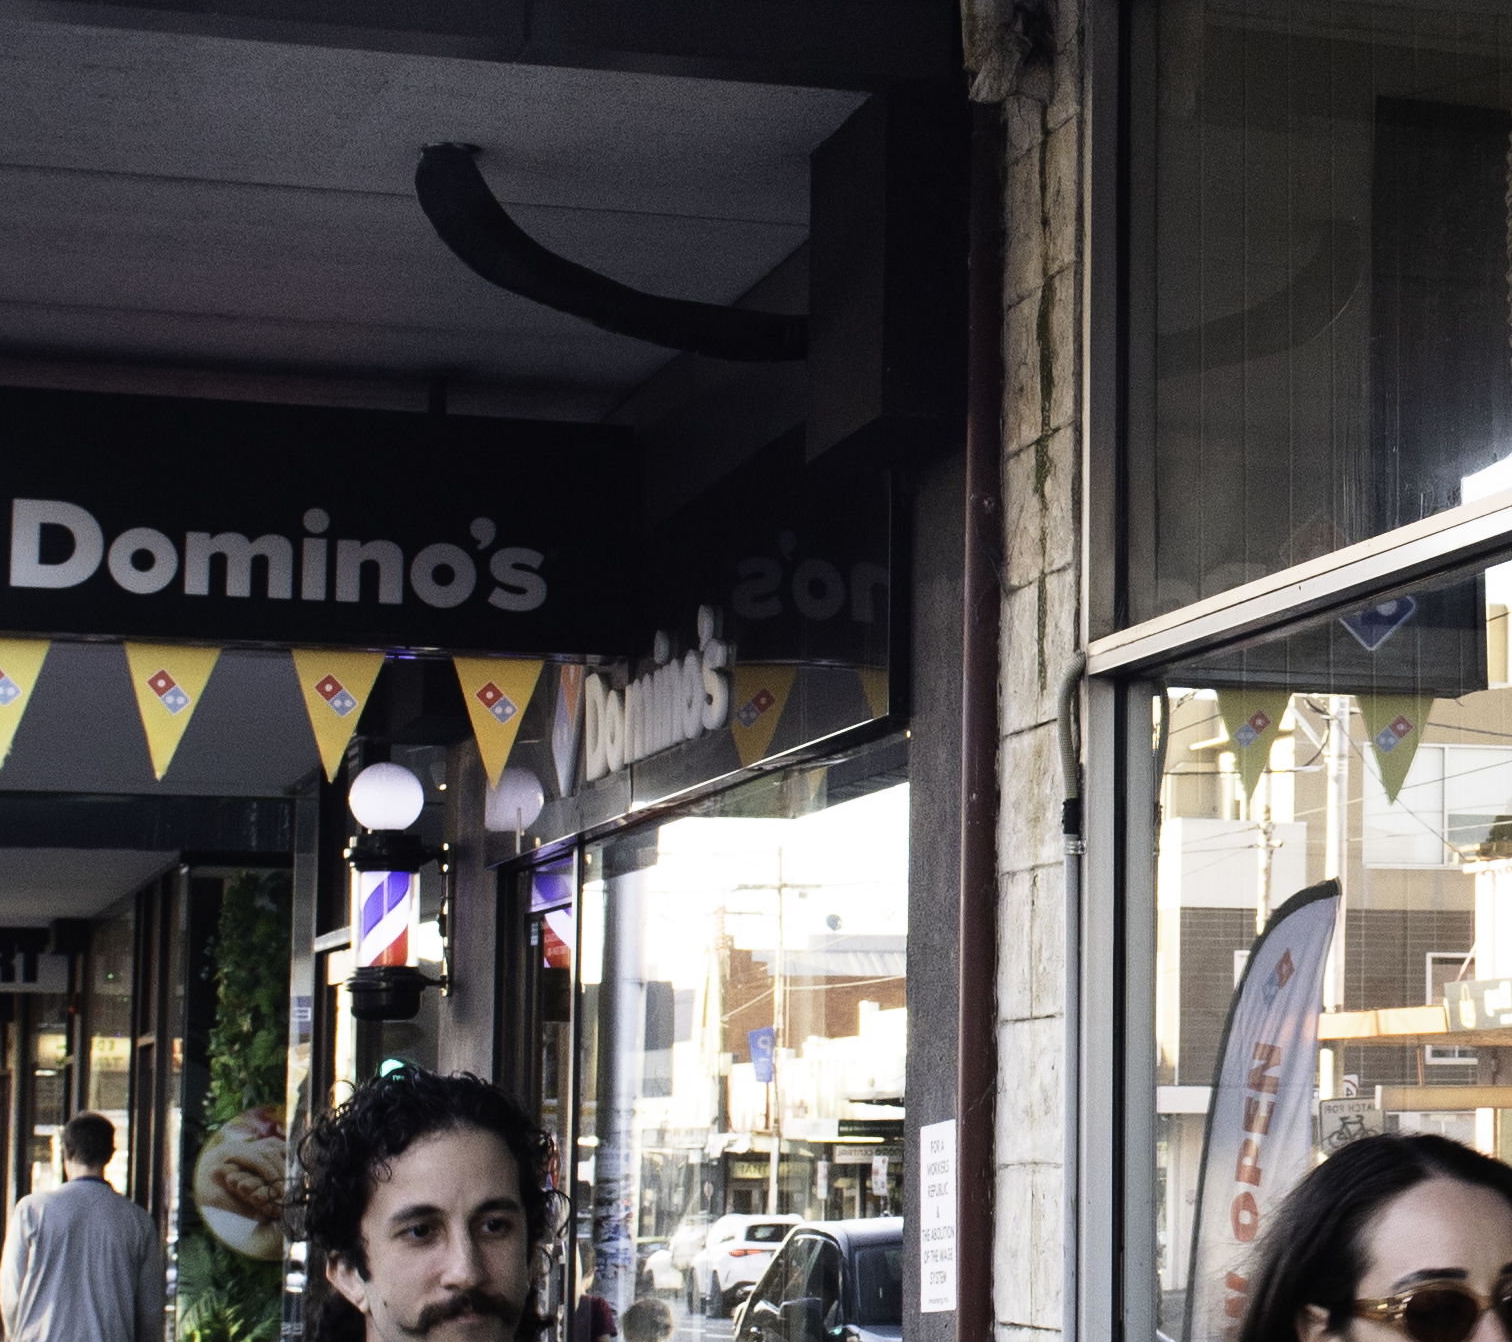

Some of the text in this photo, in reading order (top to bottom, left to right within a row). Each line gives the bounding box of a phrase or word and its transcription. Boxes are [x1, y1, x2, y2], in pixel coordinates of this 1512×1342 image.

[9, 497, 549, 614] Domino's
[584, 604, 729, 782] Domino's
[1230, 1041, 1282, 1243] OPEN
